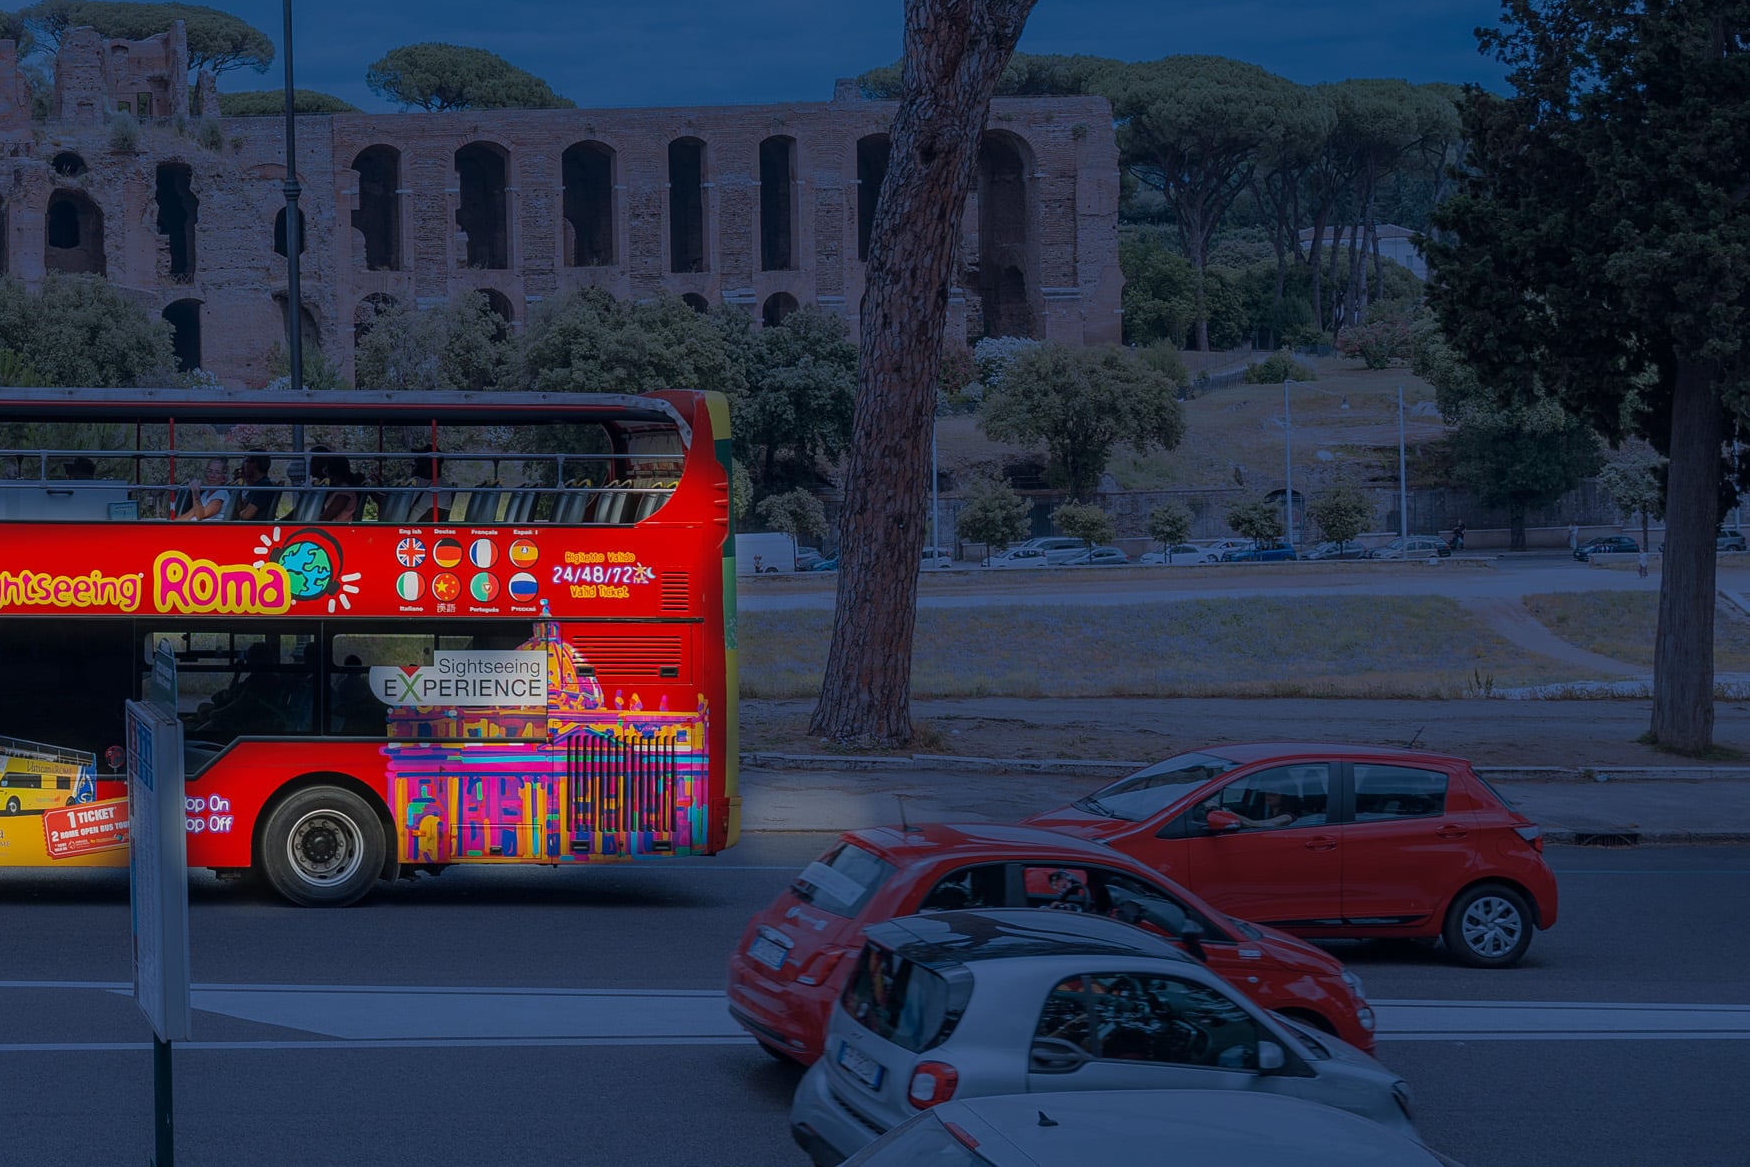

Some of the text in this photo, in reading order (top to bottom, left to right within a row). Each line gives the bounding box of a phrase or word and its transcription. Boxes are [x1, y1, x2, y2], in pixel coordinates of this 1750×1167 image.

[154, 550, 291, 614] Roma
[570, 584, 630, 599] Valid Ticket
[438, 658, 541, 678] Sightseeing
[384, 674, 542, 702] EXPERIENCE
[185, 794, 230, 813] op On
[67, 811, 77, 829] 1
[185, 814, 233, 833] op Off
[51, 831, 60, 843] 2
[80, 826, 99, 836] OPEN
[115, 820, 130, 830] TOU
